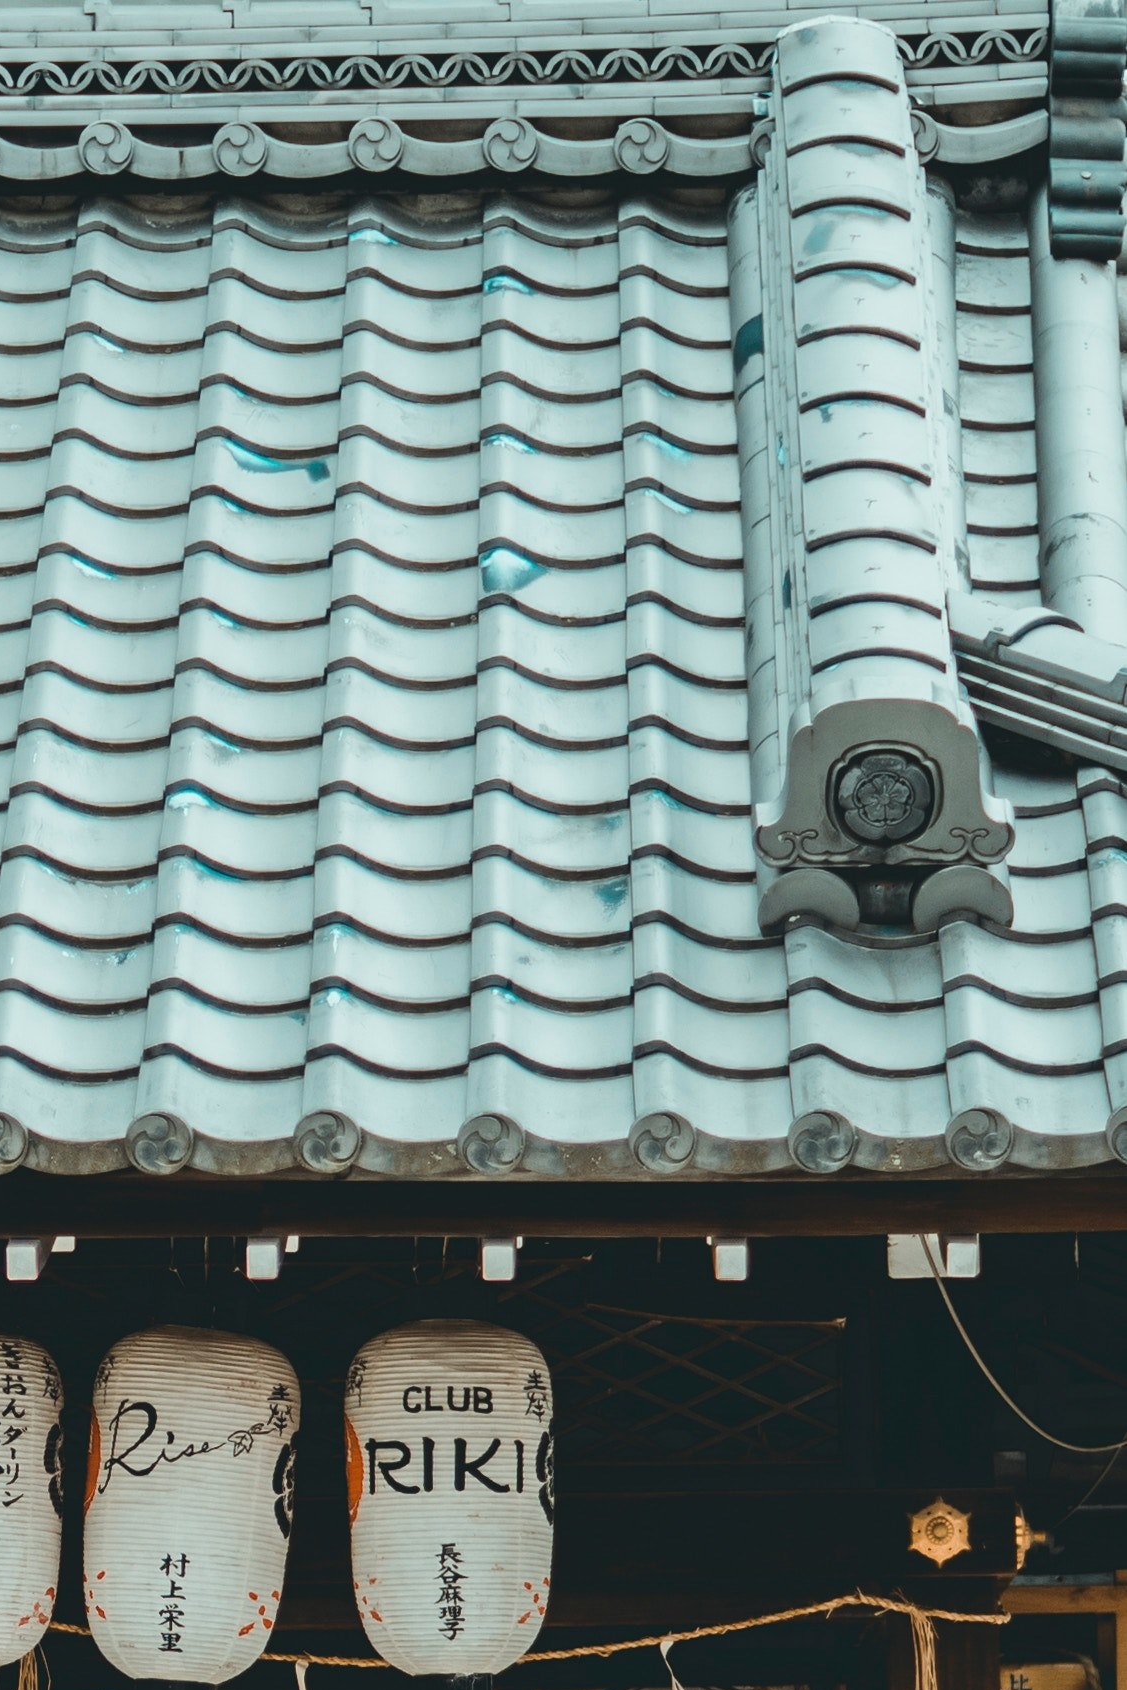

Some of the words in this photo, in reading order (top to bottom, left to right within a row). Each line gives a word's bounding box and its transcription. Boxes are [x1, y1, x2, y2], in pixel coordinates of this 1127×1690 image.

[97, 1398, 226, 1494] Rise
[402, 1385, 494, 1414] CLUB
[365, 1436, 524, 1495] RIKI
[158, 1553, 191, 1653] 村上栄里
[435, 1543, 469, 1641] 長谷麻理子
